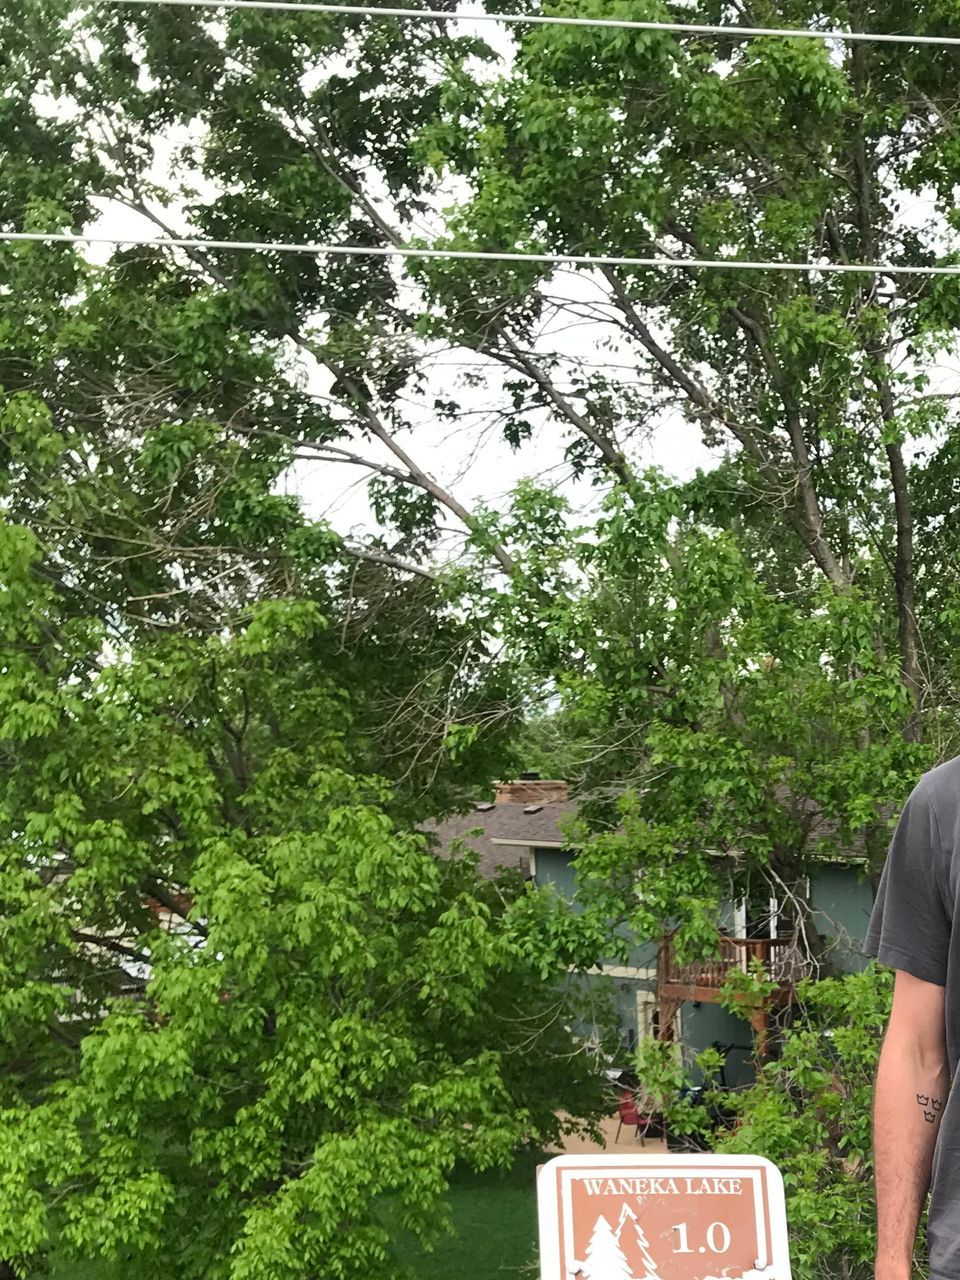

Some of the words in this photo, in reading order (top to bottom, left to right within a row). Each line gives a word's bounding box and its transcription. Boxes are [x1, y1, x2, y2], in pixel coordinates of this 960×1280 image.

[583, 1178, 680, 1196] WANEKA
[685, 1178, 743, 1195] LAKE
[671, 1222, 732, 1254] 1.0
